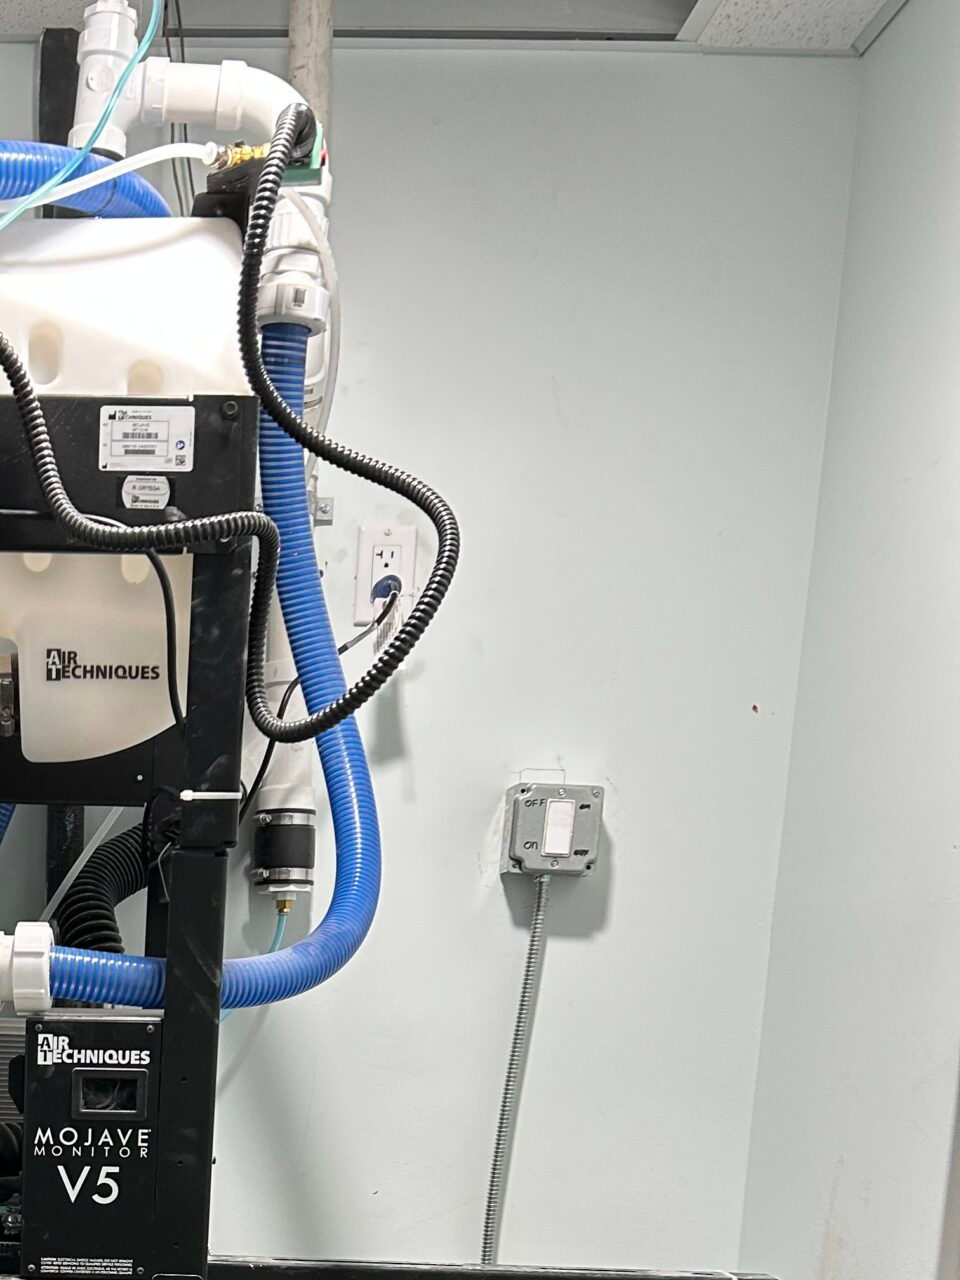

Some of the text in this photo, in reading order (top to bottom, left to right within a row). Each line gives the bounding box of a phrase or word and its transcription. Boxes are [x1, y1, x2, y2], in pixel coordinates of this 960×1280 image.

[47, 649, 78, 665] AIR
[46, 664, 160, 681] TECHNIQUES
[524, 798, 546, 808] OFF
[37, 1034, 69, 1050] AIR
[37, 1048, 150, 1065] TECHNIQUES
[34, 1145, 147, 1158] MONITOR
[57, 1165, 120, 1204] V5
